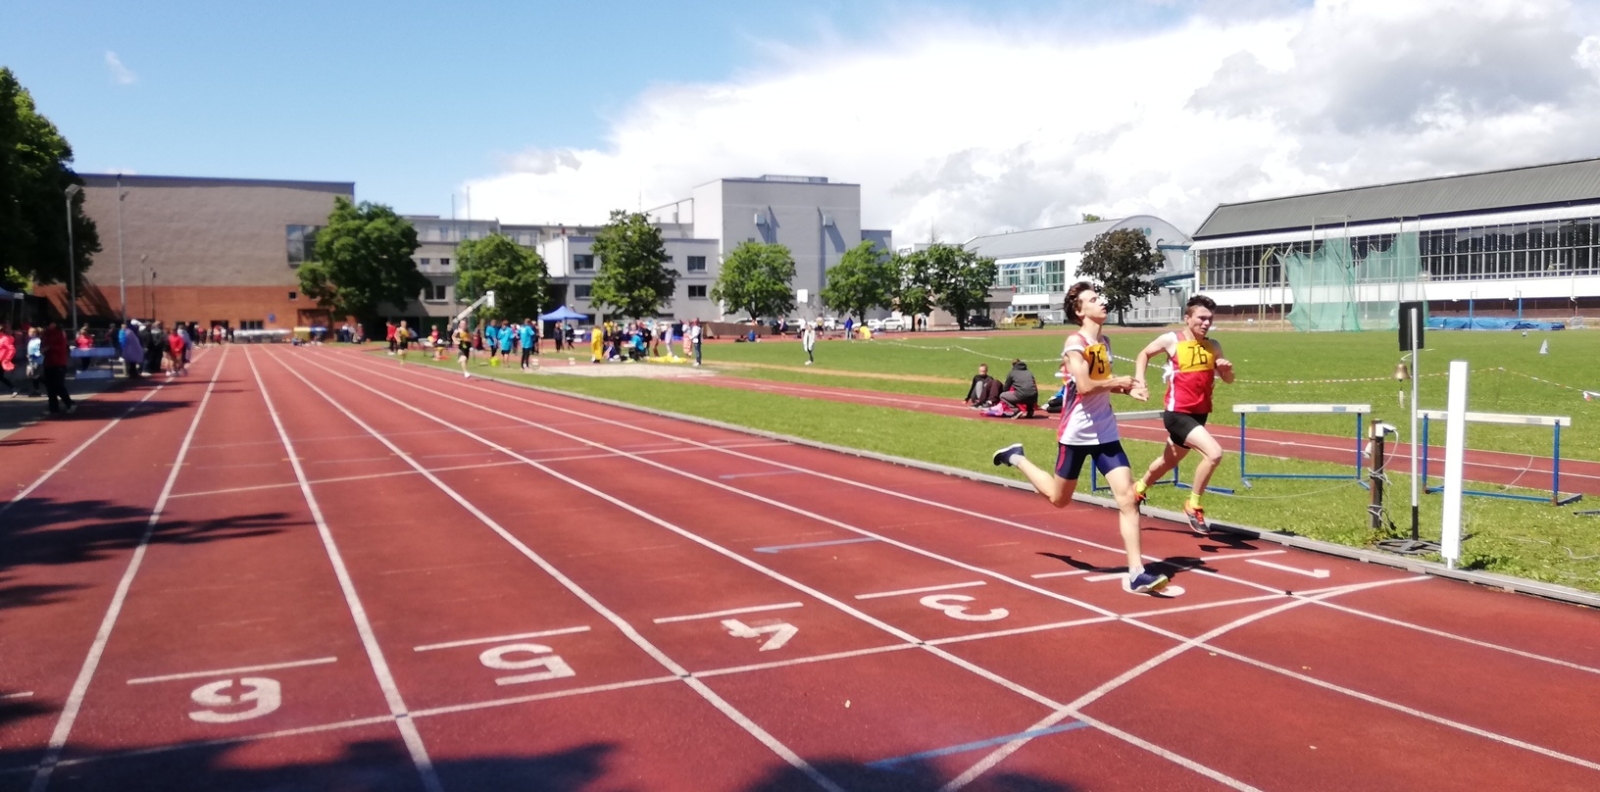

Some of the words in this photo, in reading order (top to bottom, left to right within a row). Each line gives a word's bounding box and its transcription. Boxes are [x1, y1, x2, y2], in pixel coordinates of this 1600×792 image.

[1088, 350, 1105, 375] 75
[1187, 345, 1208, 367] 76
[919, 593, 1010, 622] 3
[720, 618, 799, 652] 4
[479, 643, 576, 686] 5
[188, 677, 281, 723] 6
